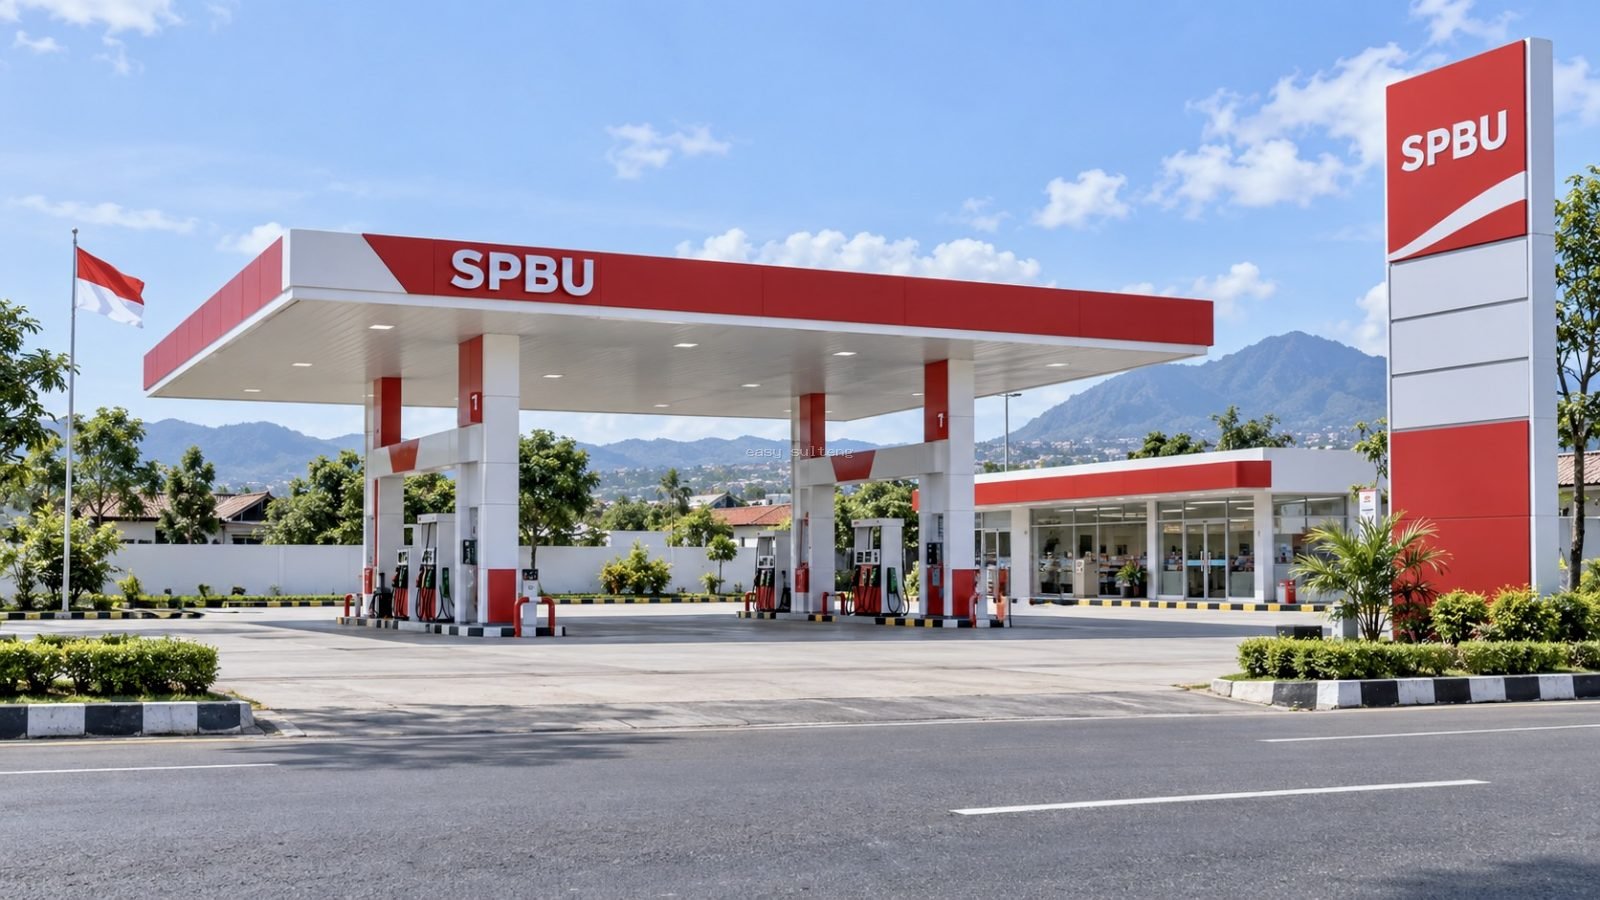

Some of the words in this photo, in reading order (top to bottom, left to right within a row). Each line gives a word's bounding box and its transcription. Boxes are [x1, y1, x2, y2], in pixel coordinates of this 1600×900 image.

[1401, 109, 1507, 172] SPBU
[450, 249, 595, 297] SPBU
[471, 394, 478, 411] 1
[937, 412, 944, 428] 1
